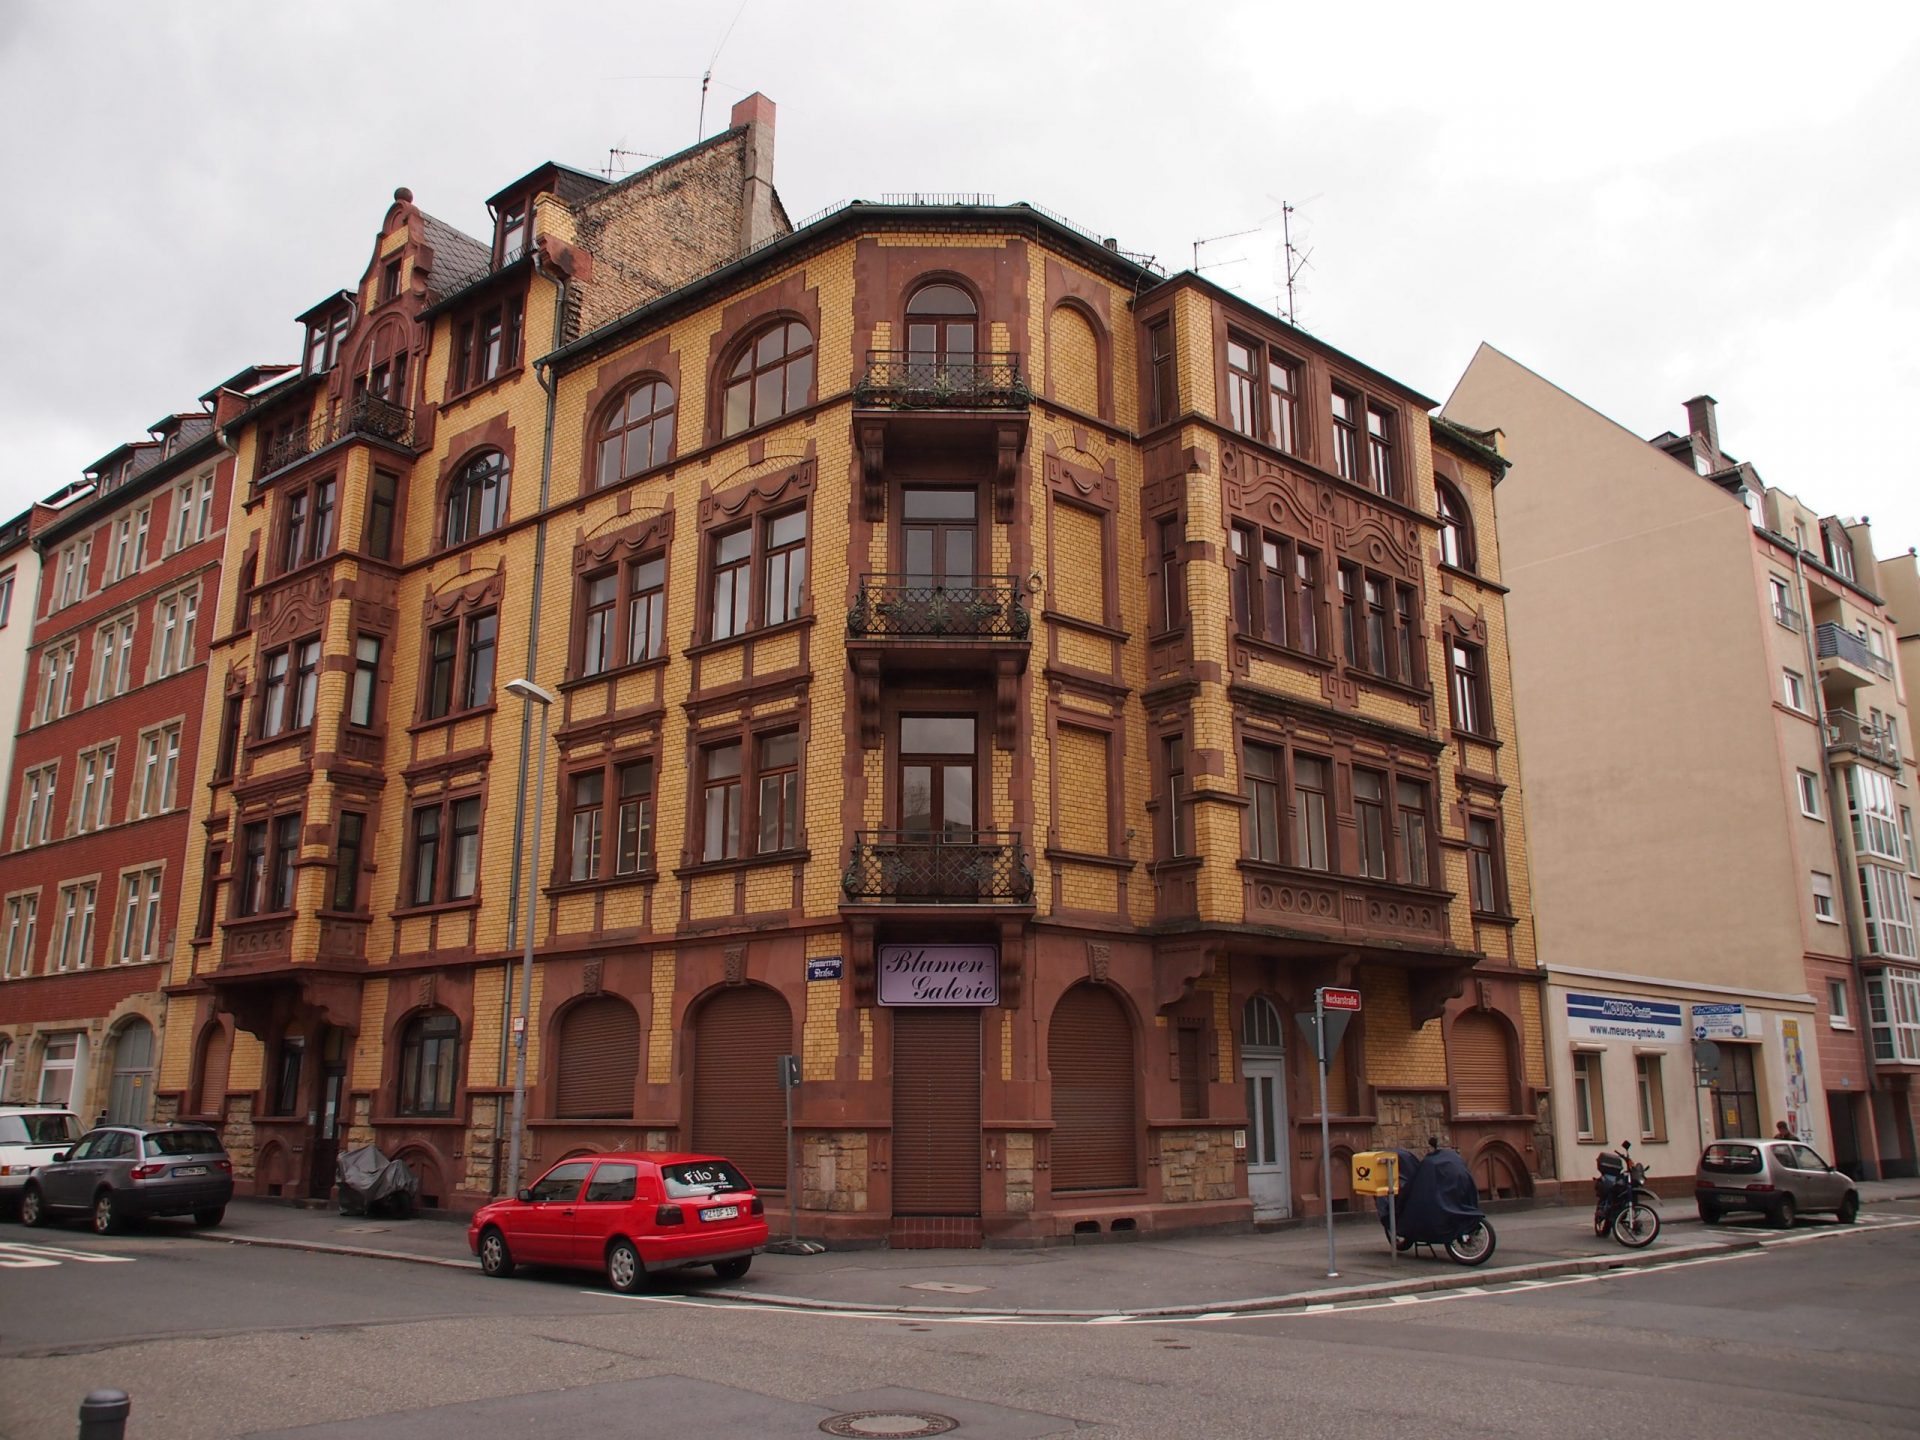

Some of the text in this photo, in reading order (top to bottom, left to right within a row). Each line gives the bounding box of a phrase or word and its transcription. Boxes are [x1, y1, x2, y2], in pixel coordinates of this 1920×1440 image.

[886, 950, 992, 972] Blumen-
[912, 976, 992, 999] Galerie
[1325, 993, 1357, 1006] Neckarstraße
[1589, 1025, 1665, 1039] www.meures-gmbh.de
